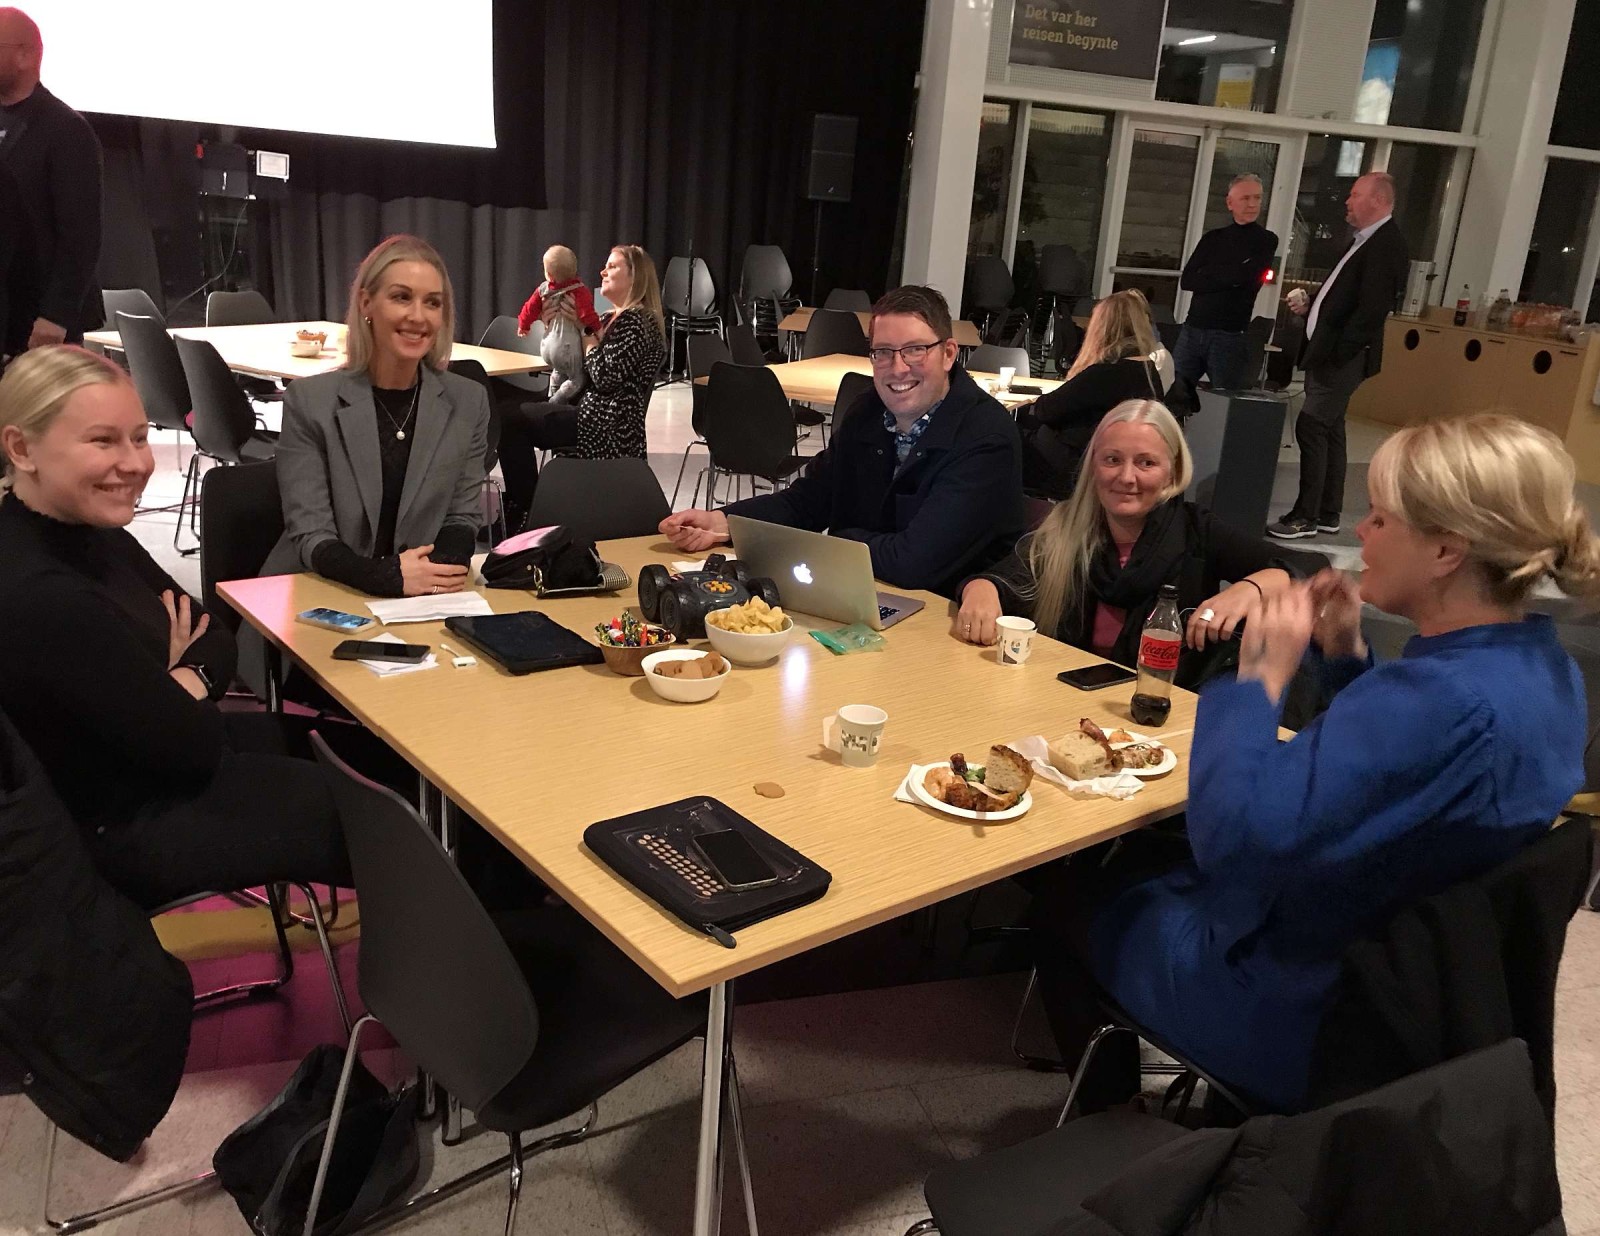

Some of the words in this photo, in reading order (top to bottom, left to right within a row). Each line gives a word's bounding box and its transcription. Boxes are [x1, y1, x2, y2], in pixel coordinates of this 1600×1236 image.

[1024, 3, 1048, 20] Det
[1051, 10, 1073, 24] var
[1074, 9, 1098, 28] her
[1022, 26, 1064, 44] reisen
[1066, 29, 1119, 51] begynte
